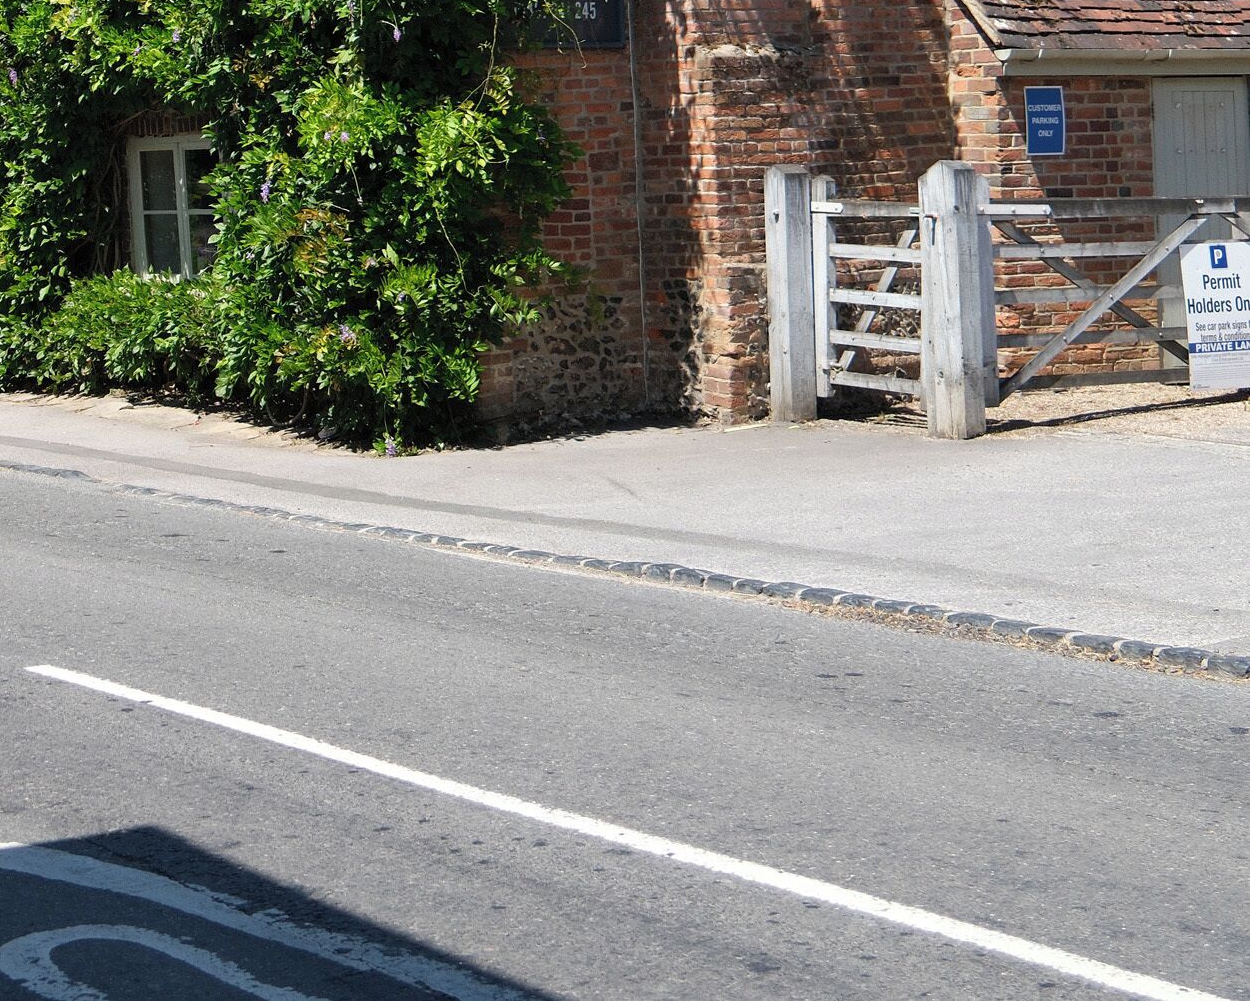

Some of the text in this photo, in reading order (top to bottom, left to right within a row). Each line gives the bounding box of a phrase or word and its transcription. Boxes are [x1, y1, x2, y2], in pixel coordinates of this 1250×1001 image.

[575, 1, 597, 19] 245
[1213, 249, 1223, 265] P
[1202, 273, 1241, 290] Permit
[1187, 295, 1250, 314] Holders On
[1195, 319, 1247, 333] See car park signs
[1200, 333, 1217, 342] terms
[1224, 330, 1250, 340] condition
[1195, 340, 1250, 353] PRIVATE LAN
